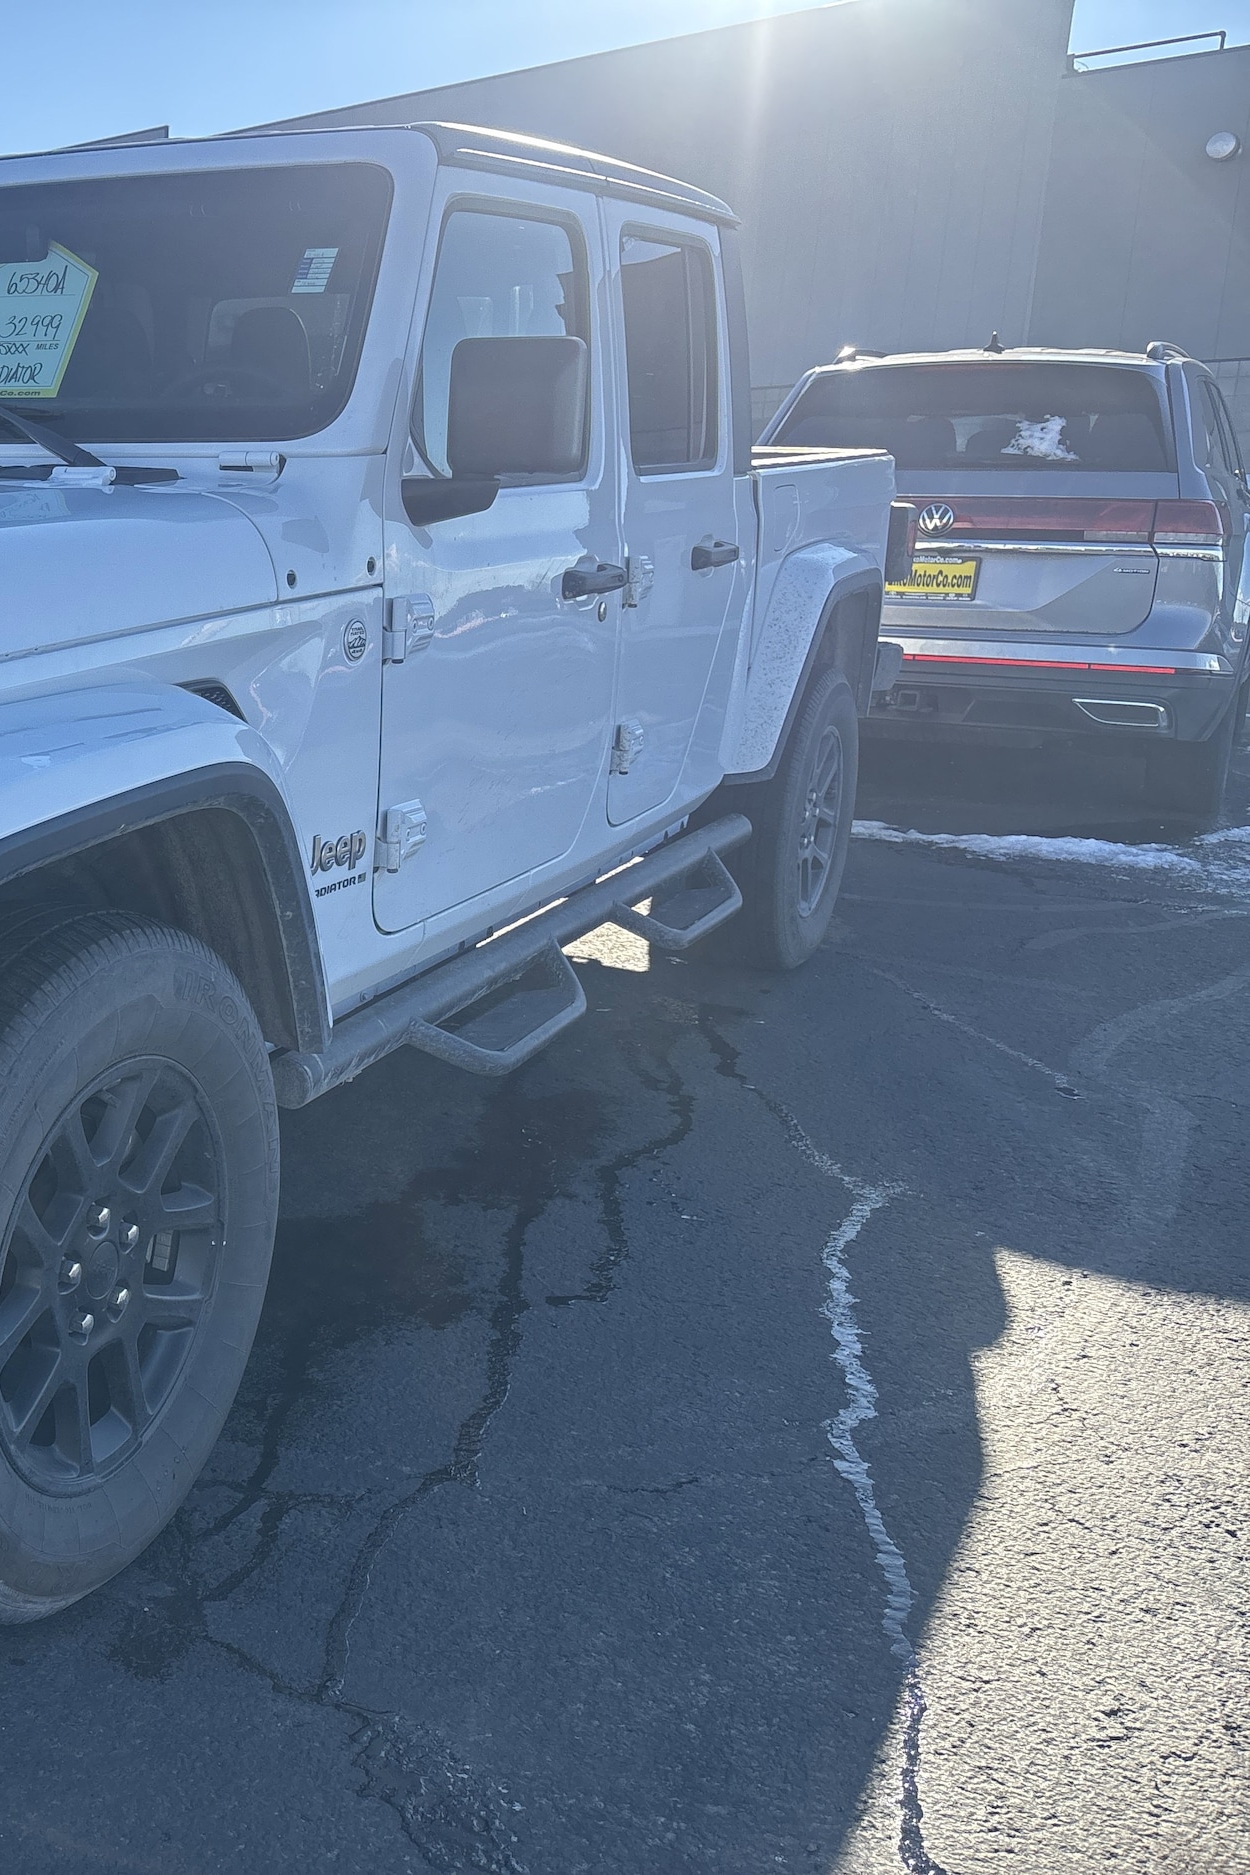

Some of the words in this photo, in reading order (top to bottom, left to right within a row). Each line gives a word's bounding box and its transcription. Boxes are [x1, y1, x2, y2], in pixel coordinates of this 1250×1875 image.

[7, 265, 68, 295] 65340A
[35, 343, 59, 351] MILES
[887, 570, 972, 588] oMotorCo.com
[311, 829, 366, 877] Jeep
